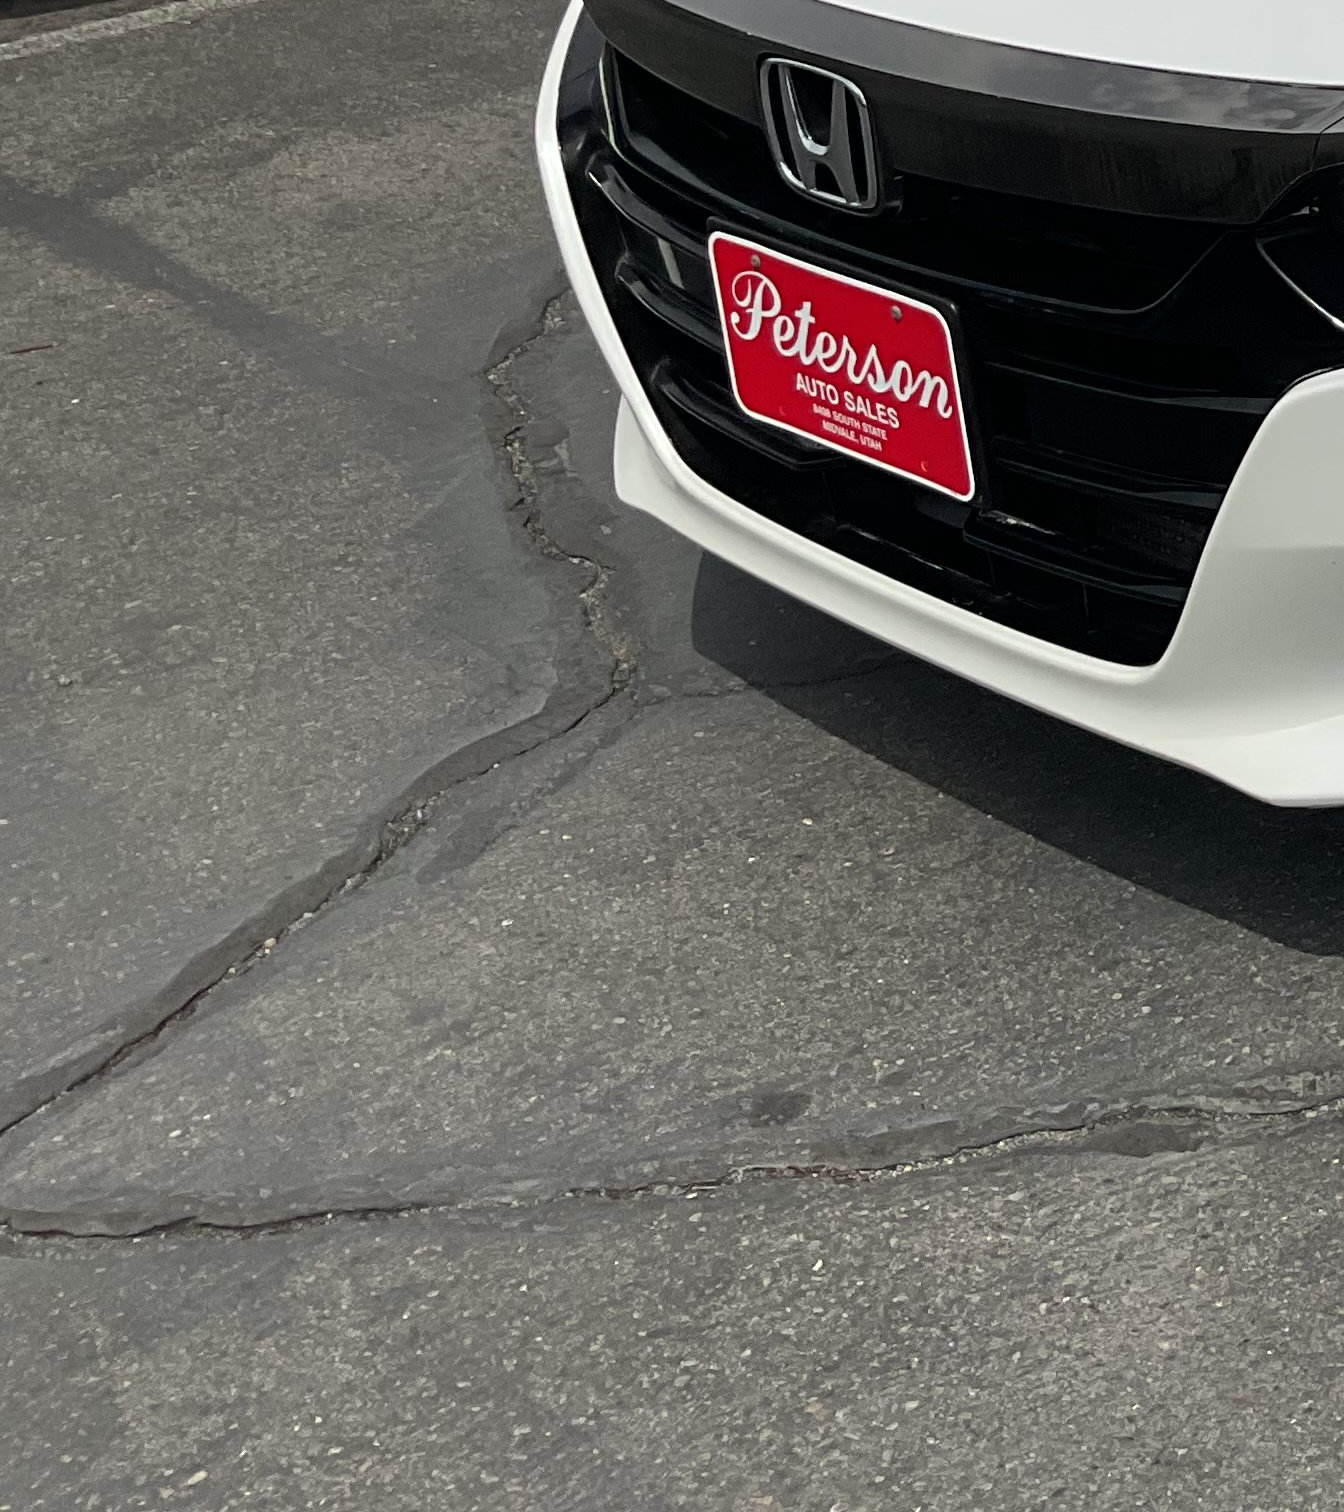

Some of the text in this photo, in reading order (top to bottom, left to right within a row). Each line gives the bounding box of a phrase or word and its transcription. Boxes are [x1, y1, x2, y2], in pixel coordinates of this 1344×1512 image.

[730, 270, 953, 418] Peterson
[796, 372, 900, 429] AUTO SALES
[832, 410, 861, 429] SOUTH
[861, 422, 888, 441] STATE
[860, 434, 883, 451] UTAH
